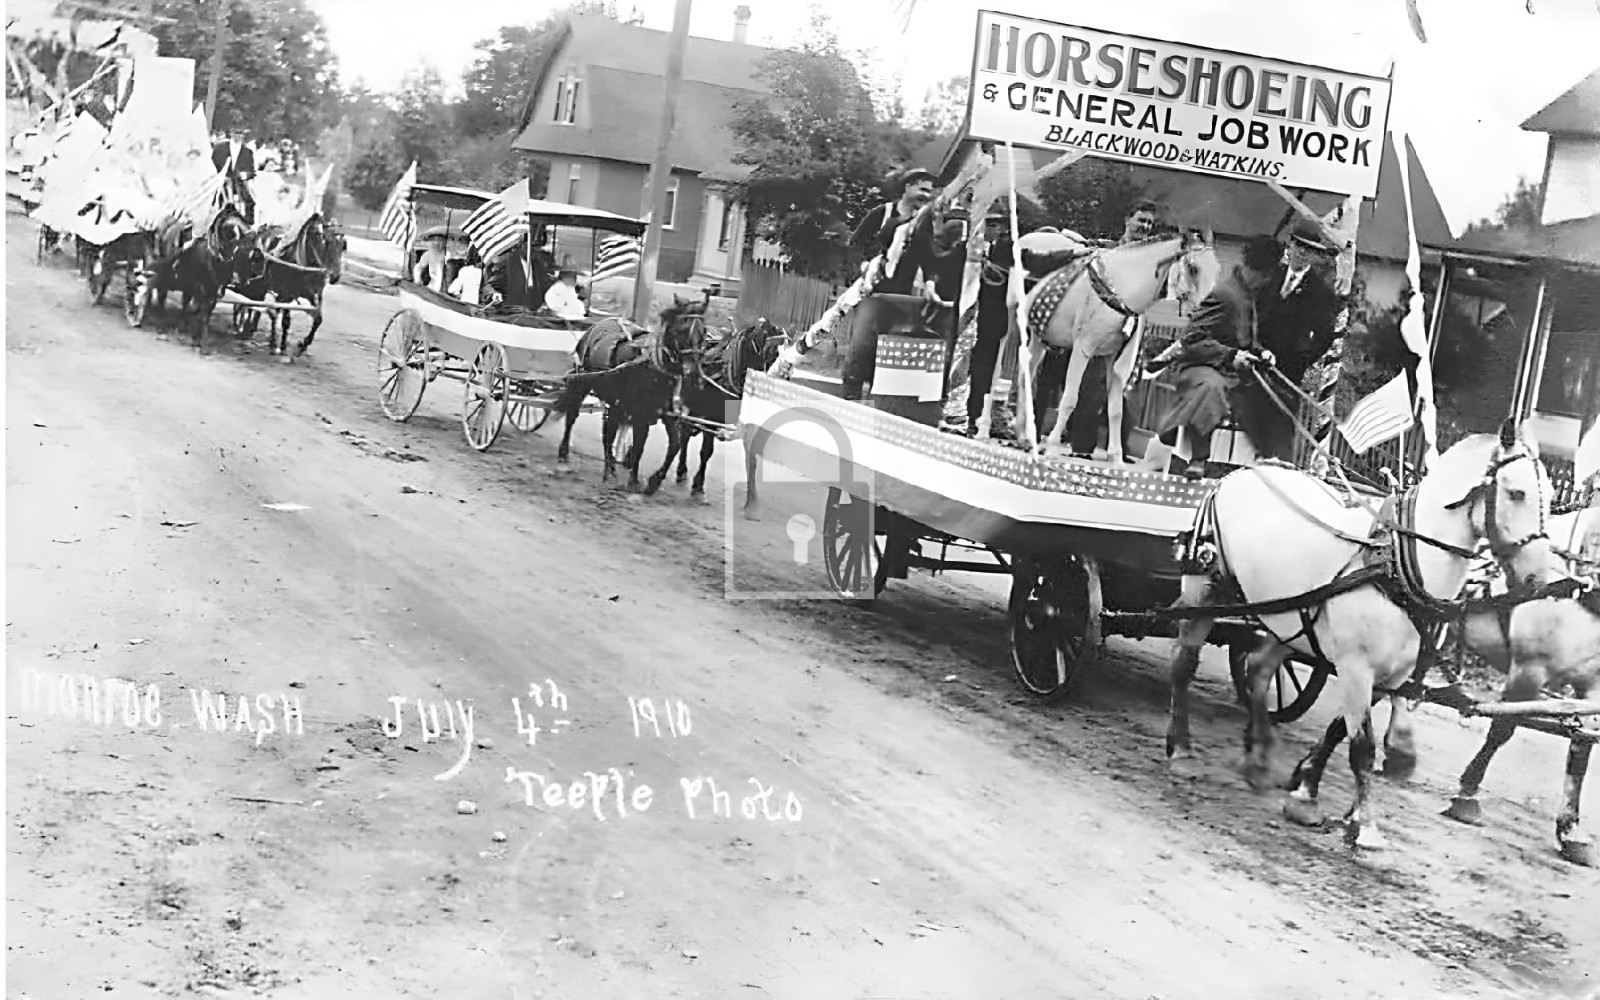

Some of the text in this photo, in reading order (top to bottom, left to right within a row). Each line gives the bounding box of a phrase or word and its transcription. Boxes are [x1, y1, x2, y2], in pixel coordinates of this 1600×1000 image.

[981, 22, 1372, 131] HORSESHOEING
[982, 82, 1371, 168] & GENERAL JOB WORK
